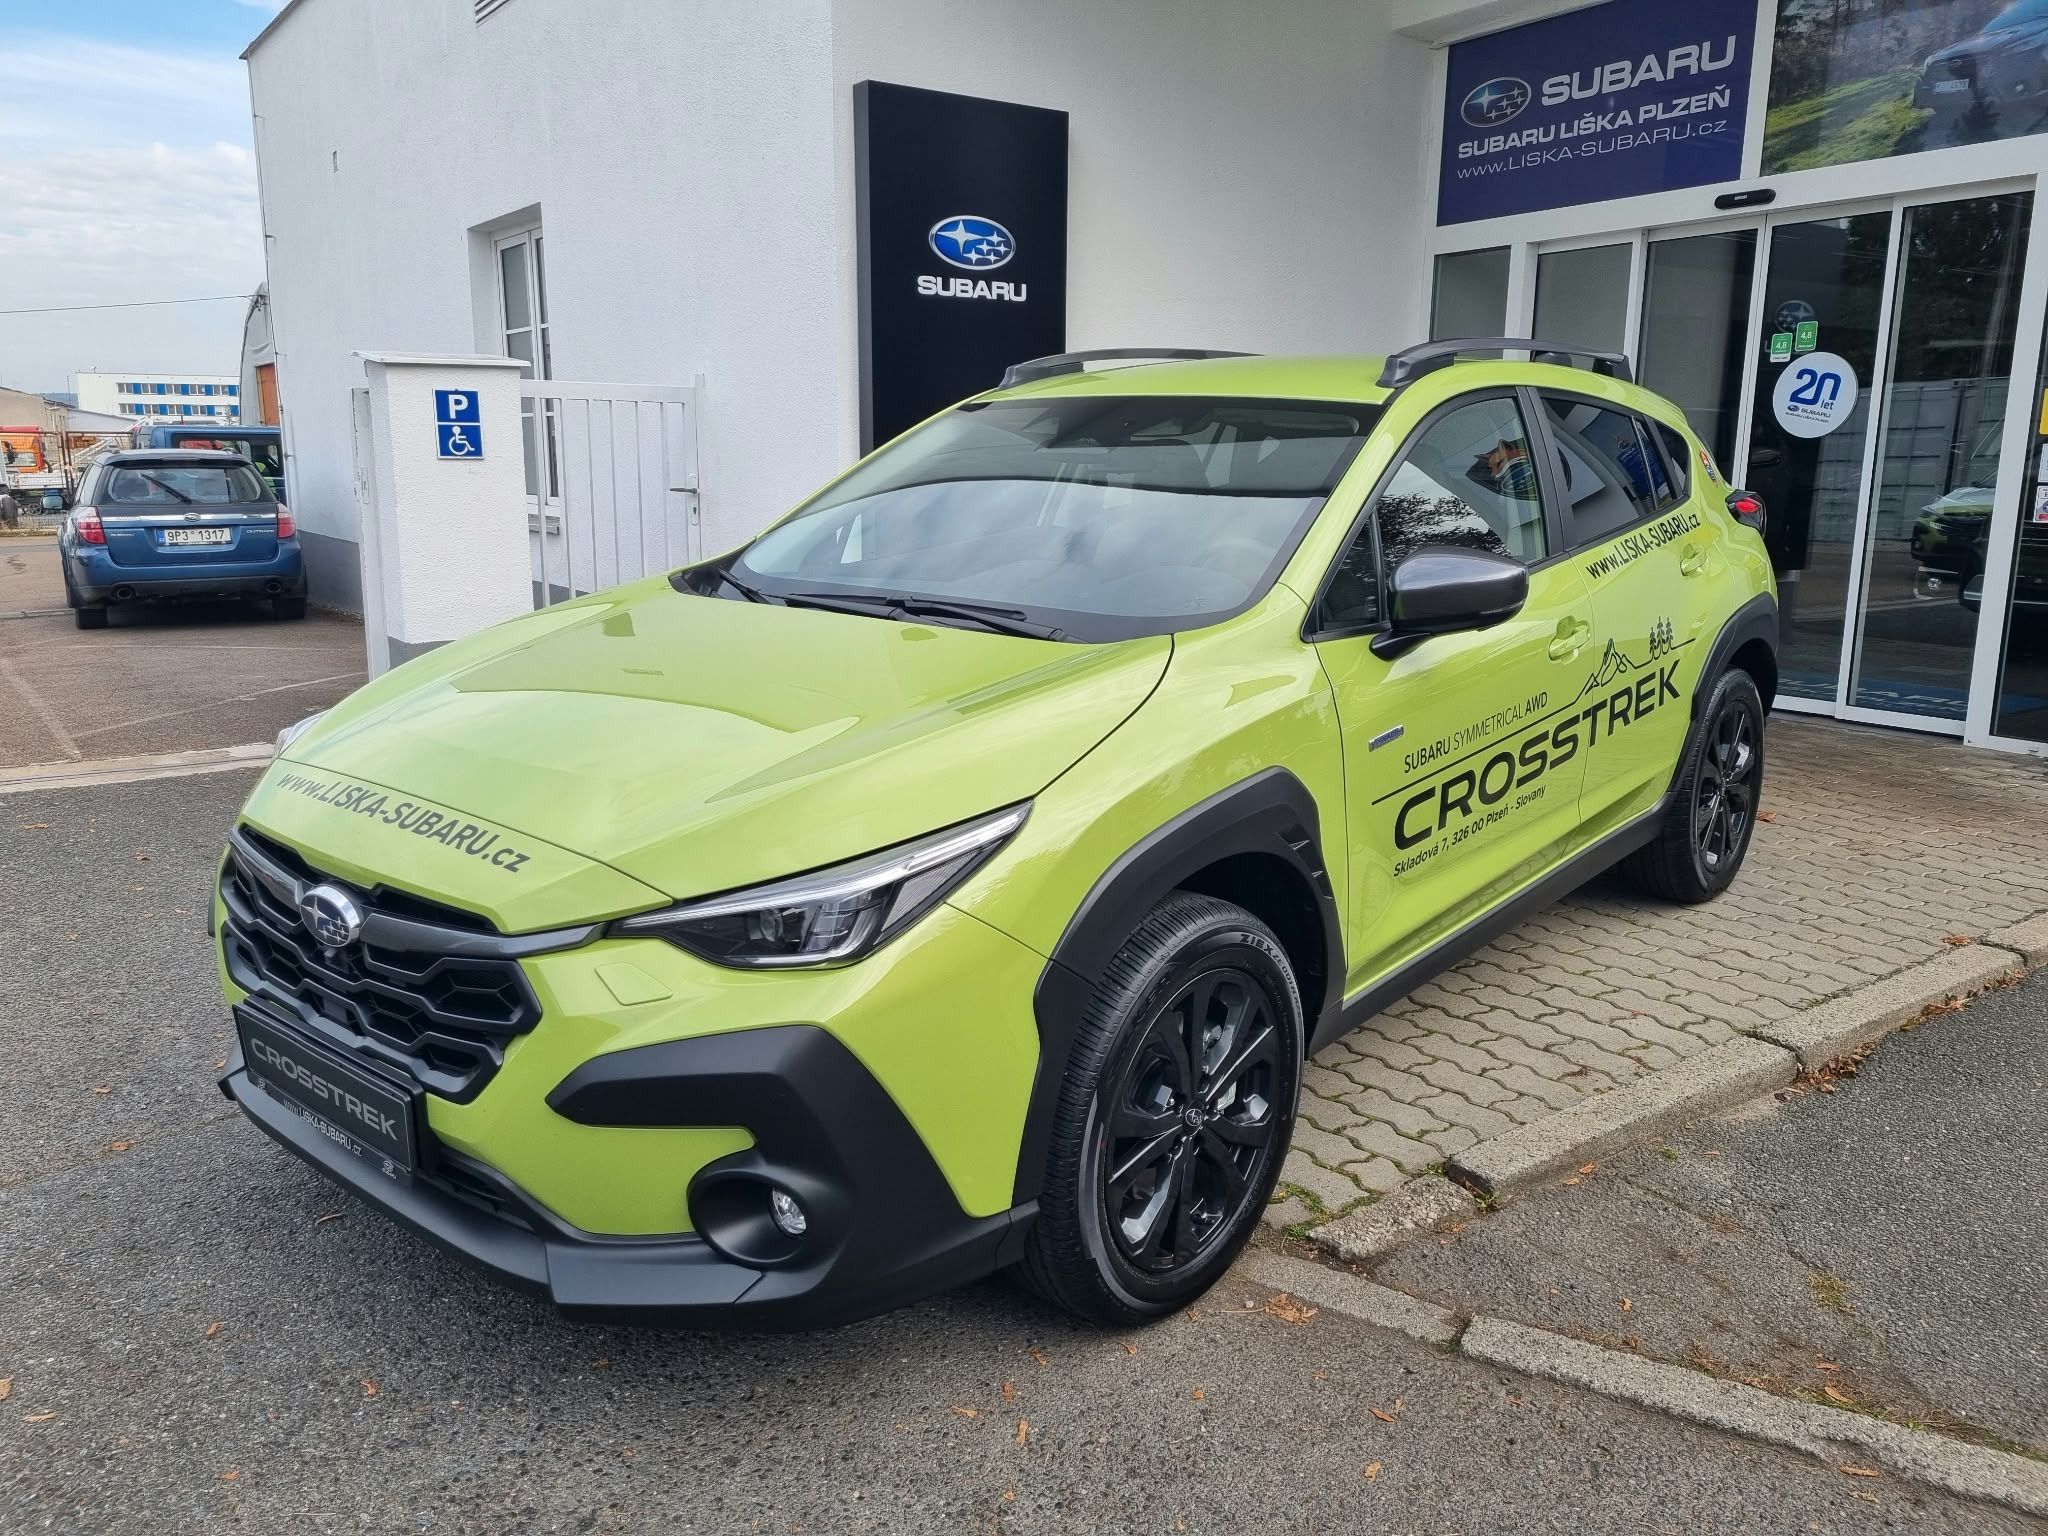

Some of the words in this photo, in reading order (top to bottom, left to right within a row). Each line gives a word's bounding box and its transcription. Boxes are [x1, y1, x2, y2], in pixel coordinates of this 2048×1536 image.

[1541, 35, 1737, 106] SUBARU
[1457, 120, 1727, 179] www.LISKA-SUBARU.cz
[1458, 126, 1555, 159] SUBARU
[1560, 111, 1634, 139] LIŠKA
[1638, 83, 1731, 124] PLZEŇ
[917, 275, 1027, 302] SUBARU
[448, 394, 468, 419] P
[1789, 368, 1842, 405] 20
[1821, 399, 1835, 410] let
[167, 530, 189, 541] 9P3
[199, 529, 225, 541] 1317
[1585, 513, 1701, 579] www.LISKA-SUBARU.cz
[1394, 659, 1681, 850] CROSSTREK
[1404, 737, 1451, 773] SUBARU
[1453, 701, 1523, 751] SYMMETRICAL
[1525, 691, 1548, 714] AWD
[276, 773, 531, 873] www.LISKA-SUBARU.cz
[1393, 841, 1439, 877] Skladová
[1441, 838, 1450, 853] 7,
[1452, 828, 1469, 847] 326
[1471, 819, 1484, 835] 00
[1486, 803, 1509, 828] Plzeň
[1515, 785, 1547, 811] Slovany
[1240, 933, 1275, 956] ZIEX
[251, 1038, 399, 1141] CROSSTREK
